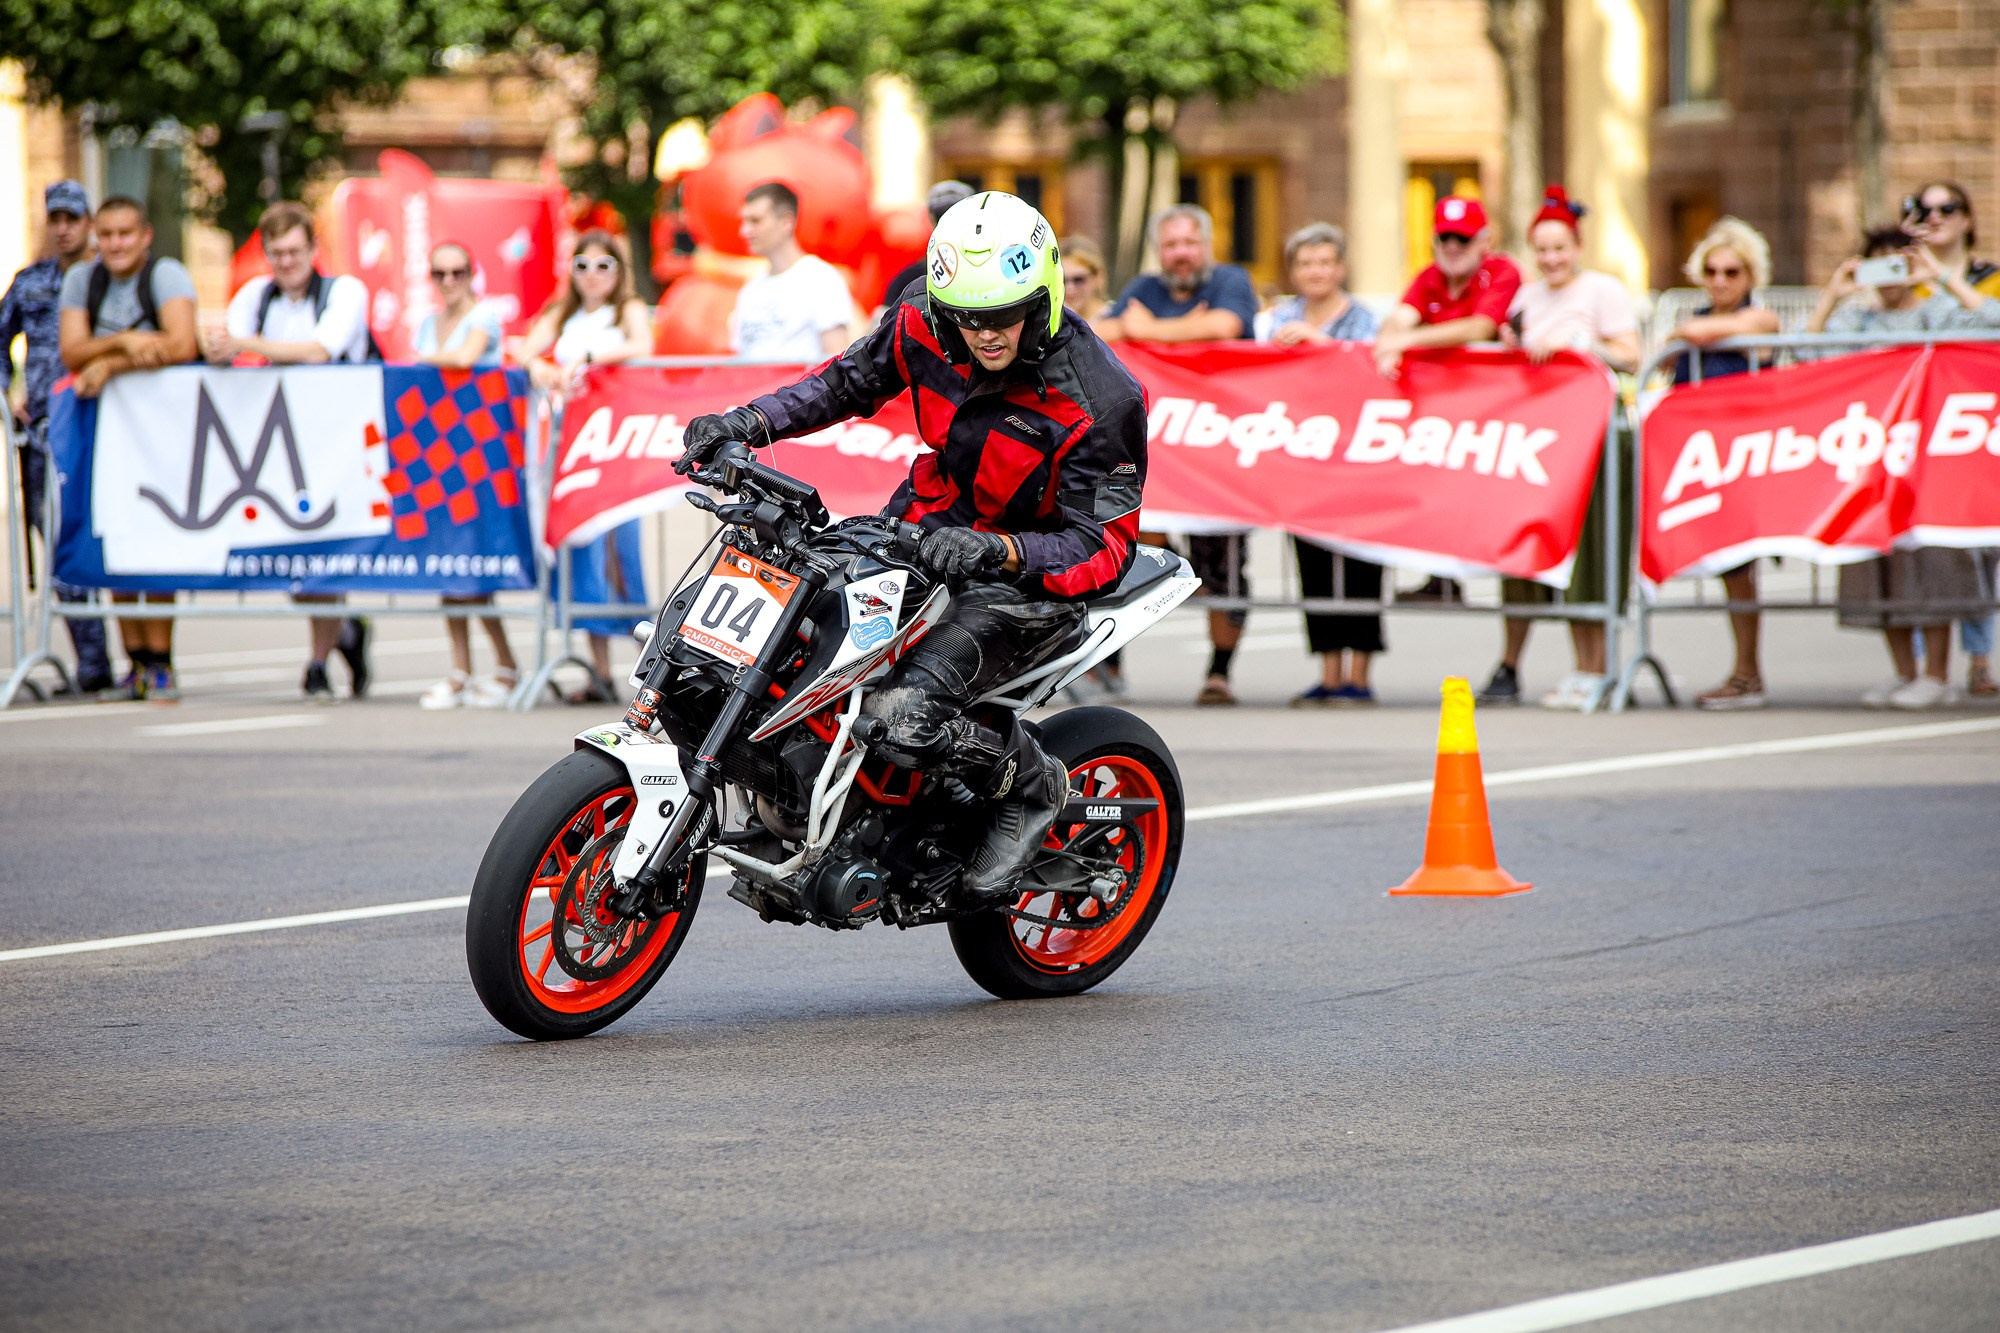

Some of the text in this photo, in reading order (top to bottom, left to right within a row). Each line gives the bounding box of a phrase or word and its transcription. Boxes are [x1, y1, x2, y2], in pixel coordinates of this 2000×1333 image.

[931, 259, 945, 281] 12
[1008, 250, 1031, 275] 12
[1005, 414, 1042, 436] RST
[1147, 396, 1559, 487] льфа Банк
[1661, 401, 1921, 504] Альфа
[226, 553, 522, 580] МОТОДЖИМХАНА РОССИИ
[700, 582, 766, 643] 04
[684, 628, 751, 664] СМОЛЕНСК
[641, 776, 677, 785] GALFER
[662, 804, 670, 815] 4
[1085, 805, 1122, 817] GALFER
[689, 803, 713, 849] GALFER
